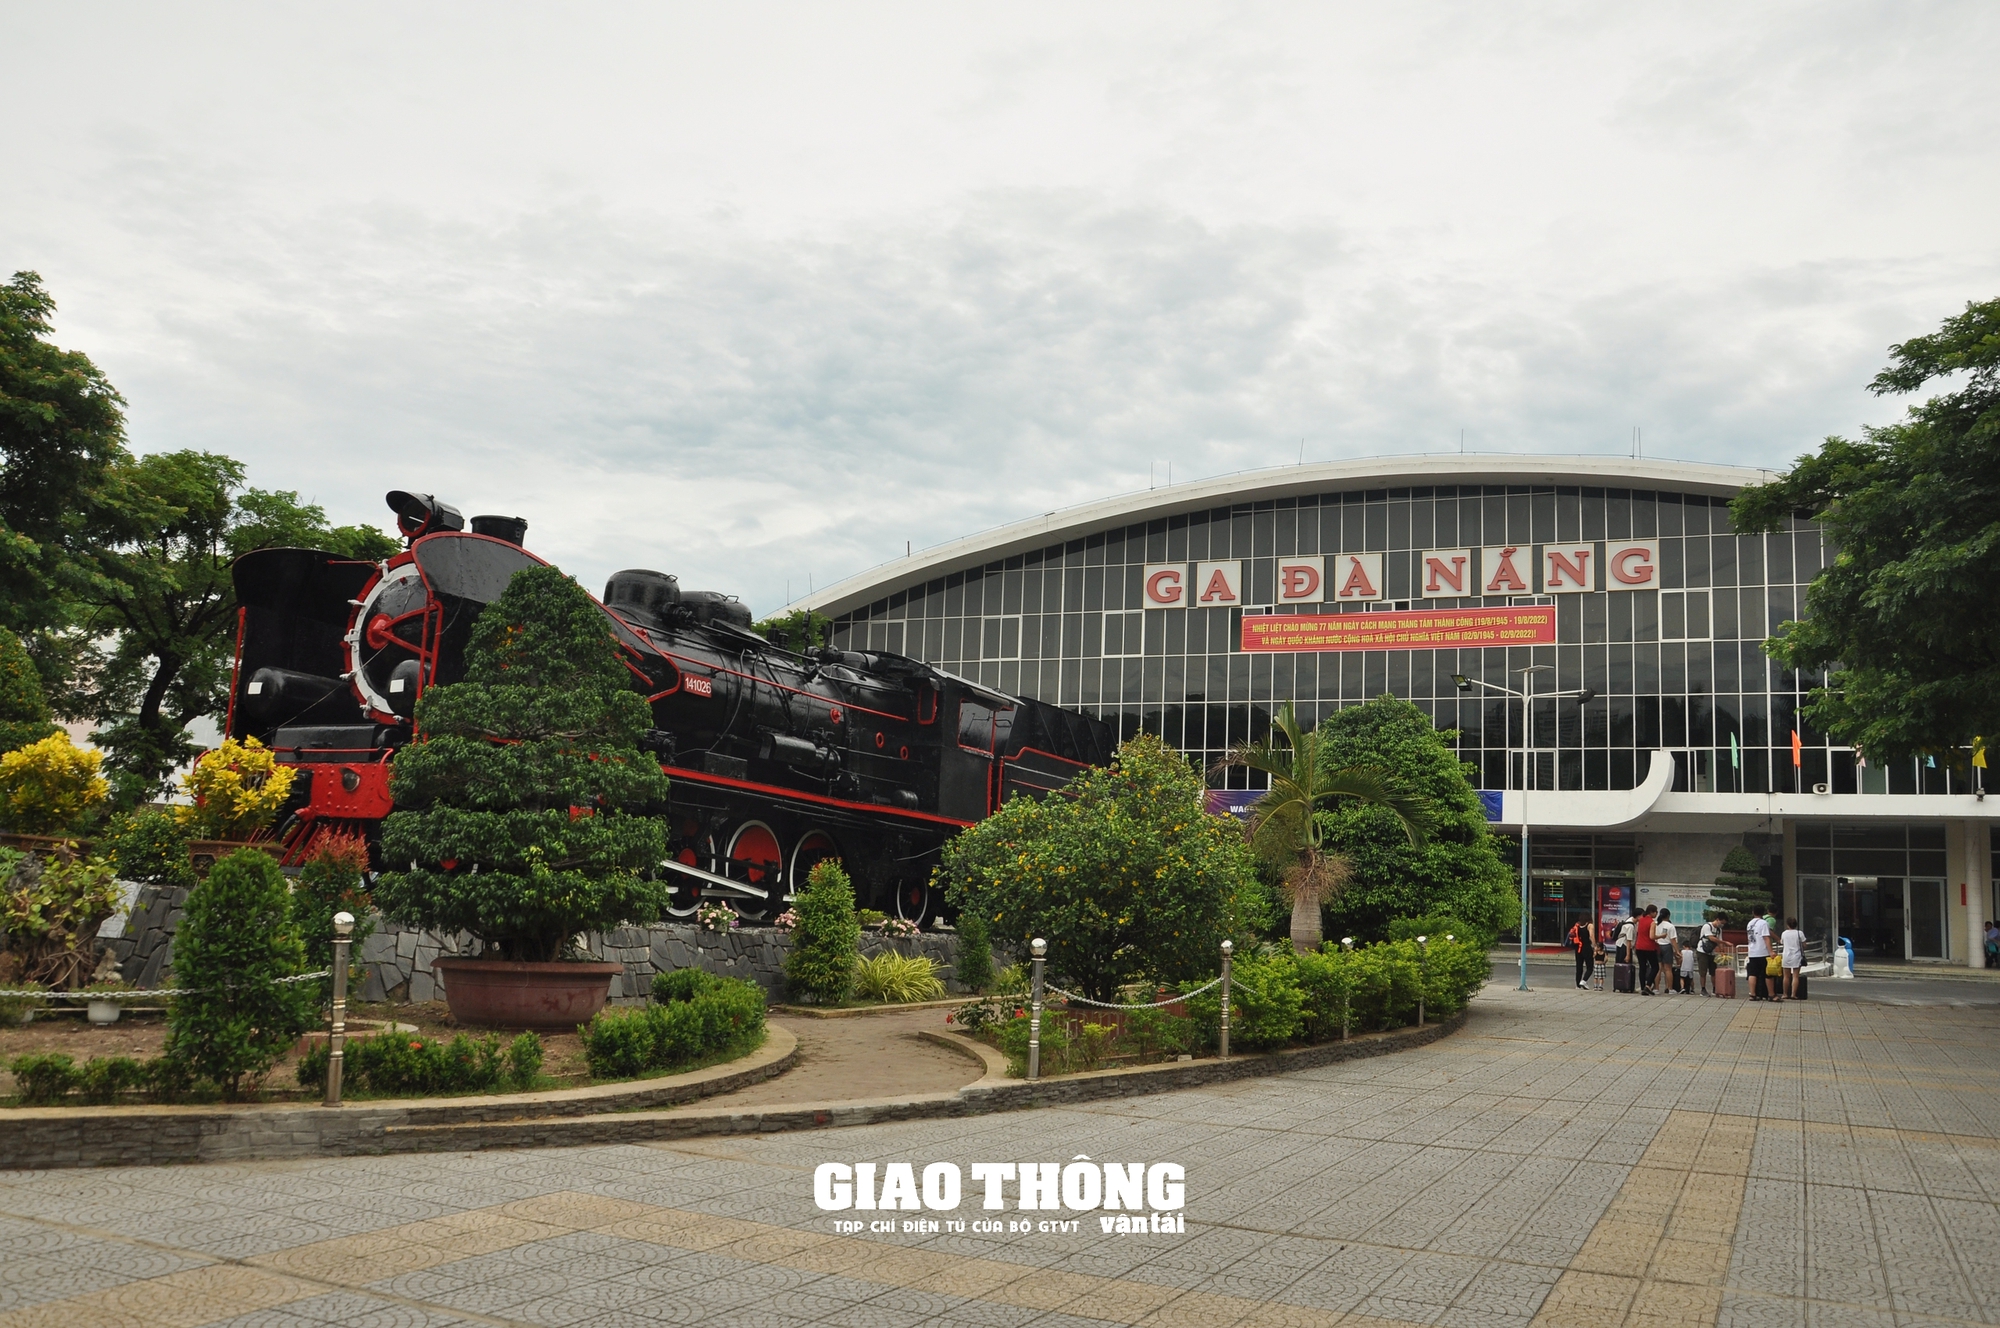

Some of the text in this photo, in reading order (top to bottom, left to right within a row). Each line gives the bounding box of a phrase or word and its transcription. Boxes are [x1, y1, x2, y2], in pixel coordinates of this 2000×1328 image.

[1147, 547, 1653, 604] GA ĐÀ NẴNG
[1252, 622, 1269, 634] NHIỆT
[1270, 622, 1283, 633] LIỆT
[1283, 621, 1299, 632] CHÀO
[1300, 621, 1318, 632] MỪNG
[1319, 622, 1327, 631] 77
[1328, 620, 1342, 631] NĂM
[1343, 620, 1360, 631] NGÀY
[1360, 620, 1377, 630] CÁCH
[1378, 620, 1397, 631] MẠNG
[1398, 618, 1418, 629] THÁNG
[1419, 618, 1433, 628] TÁM
[1434, 617, 1455, 627] THÀNH
[1456, 616, 1474, 627] CÔNG
[1474, 616, 1508, 627] (19/8/1945
[1514, 615, 1548, 625] 19/8/2022)
[1262, 635, 1270, 645] VÀ
[1270, 635, 1286, 645] NGÀY
[1343, 633, 1360, 645] CỘNG
[1384, 632, 1395, 644] HỘI
[1396, 631, 1409, 642] CHỦ
[1430, 631, 1444, 642] VIỆT
[1445, 631, 1460, 640] NAM
[685, 677, 712, 694] 141026
